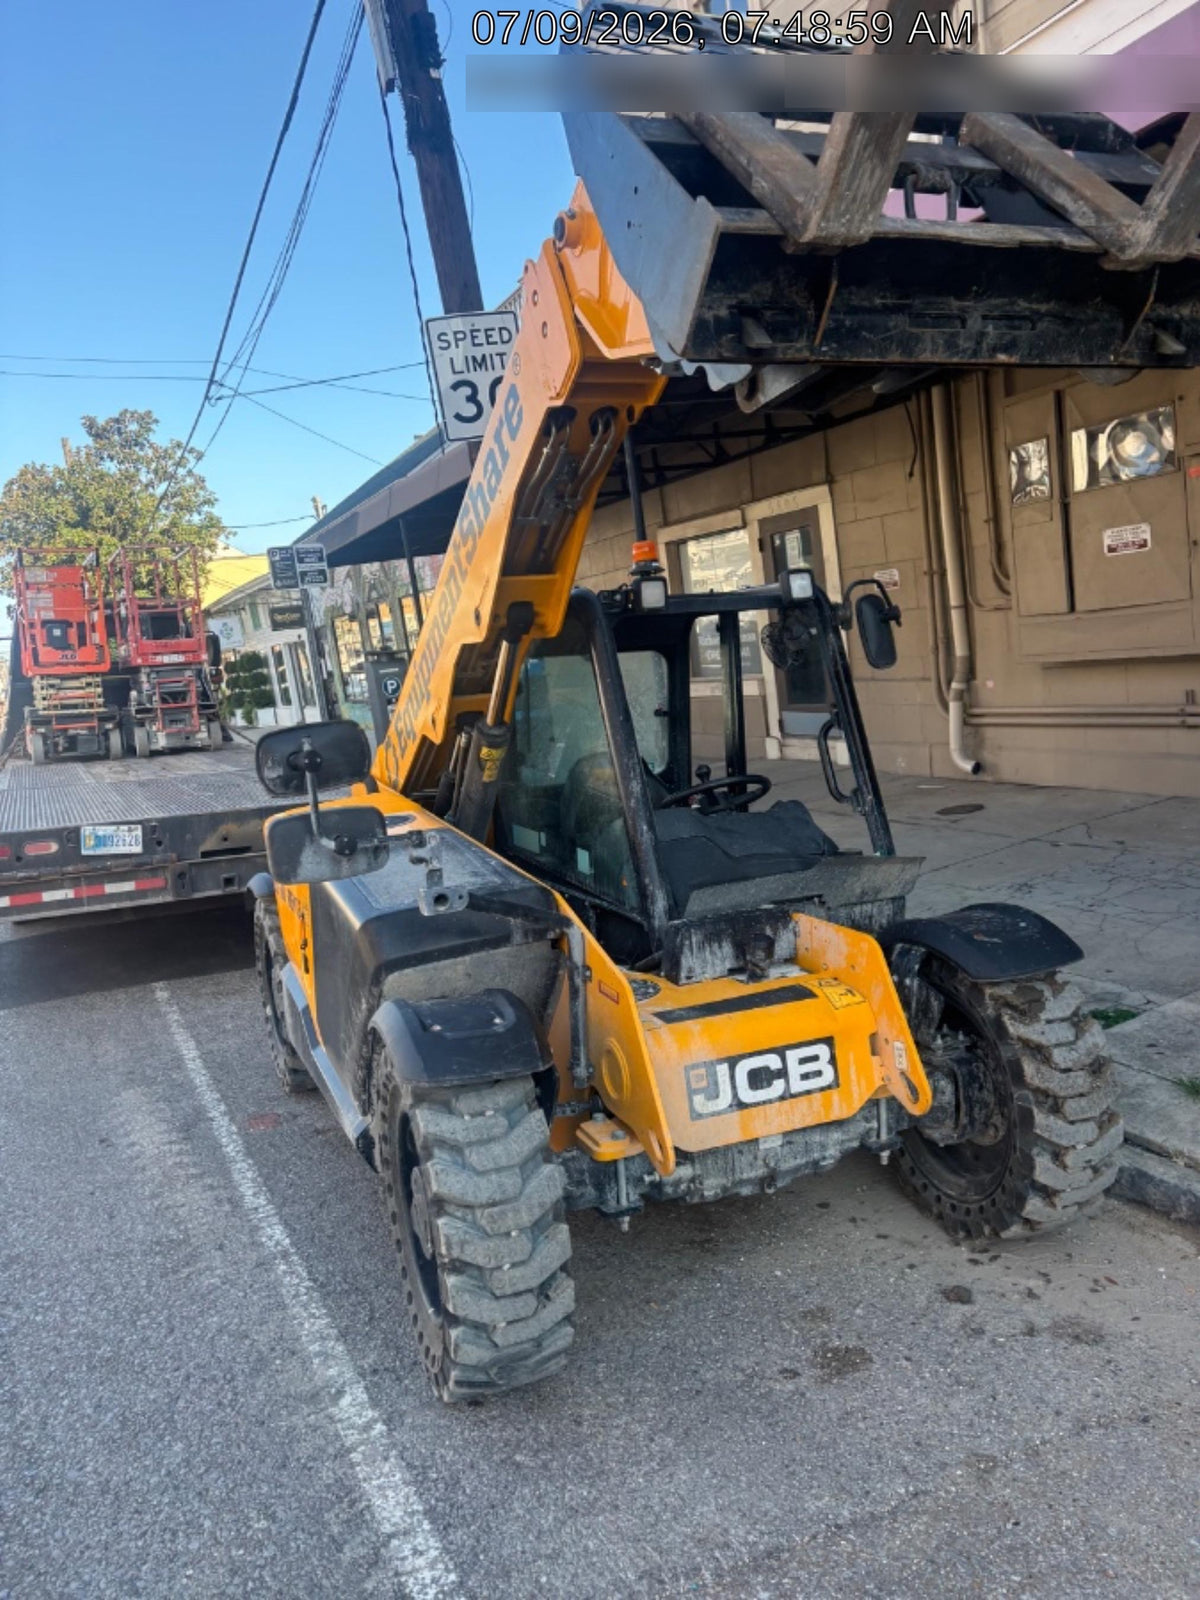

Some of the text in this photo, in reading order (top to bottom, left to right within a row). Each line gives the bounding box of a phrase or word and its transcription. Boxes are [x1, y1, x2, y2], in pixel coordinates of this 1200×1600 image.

[436, 326, 513, 351] SPEED
[449, 352, 508, 375] LIMIT
[387, 680, 398, 694] P
[691, 1042, 836, 1115] JCB
